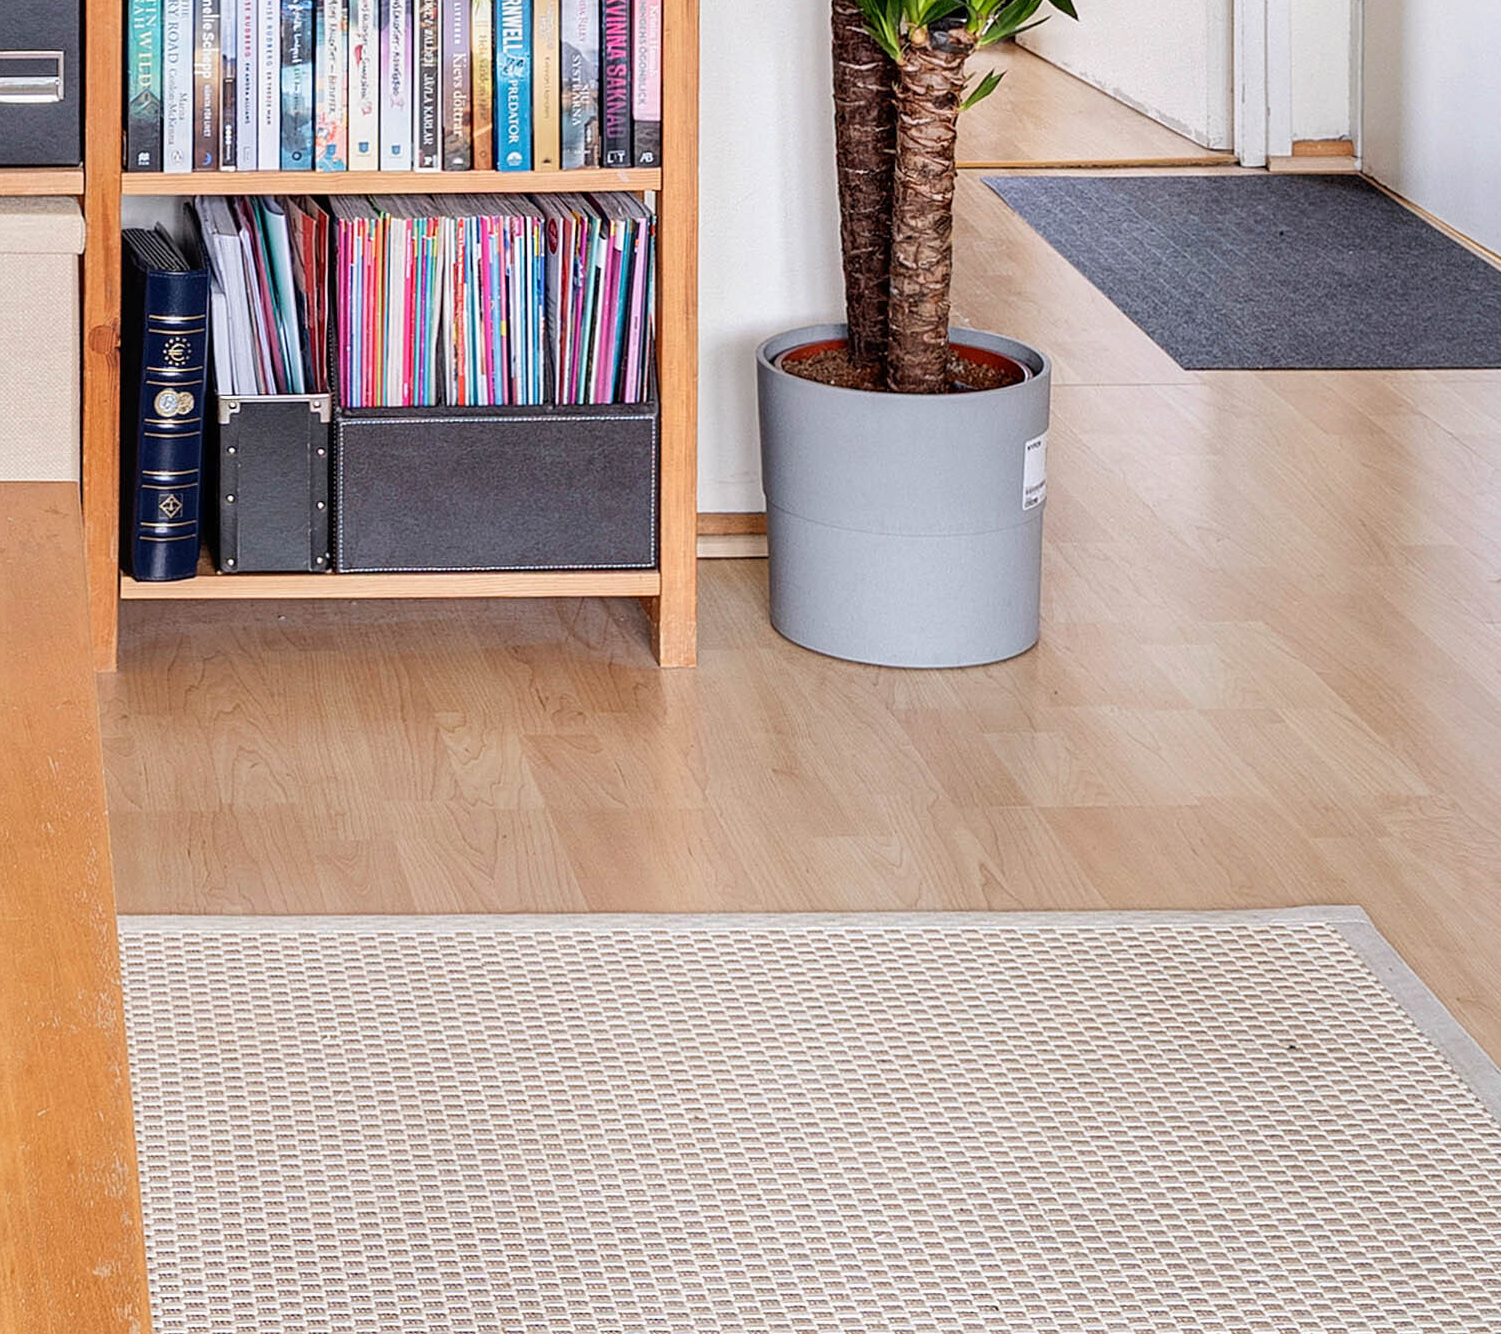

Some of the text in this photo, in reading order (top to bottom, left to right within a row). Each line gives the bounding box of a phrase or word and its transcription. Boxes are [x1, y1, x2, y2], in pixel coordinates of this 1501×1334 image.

[138, 33, 151, 87] WILD
[167, 22, 179, 64] ROAD
[507, 79, 520, 144] PREDATOR
[606, 65, 627, 139] SAKNAD
